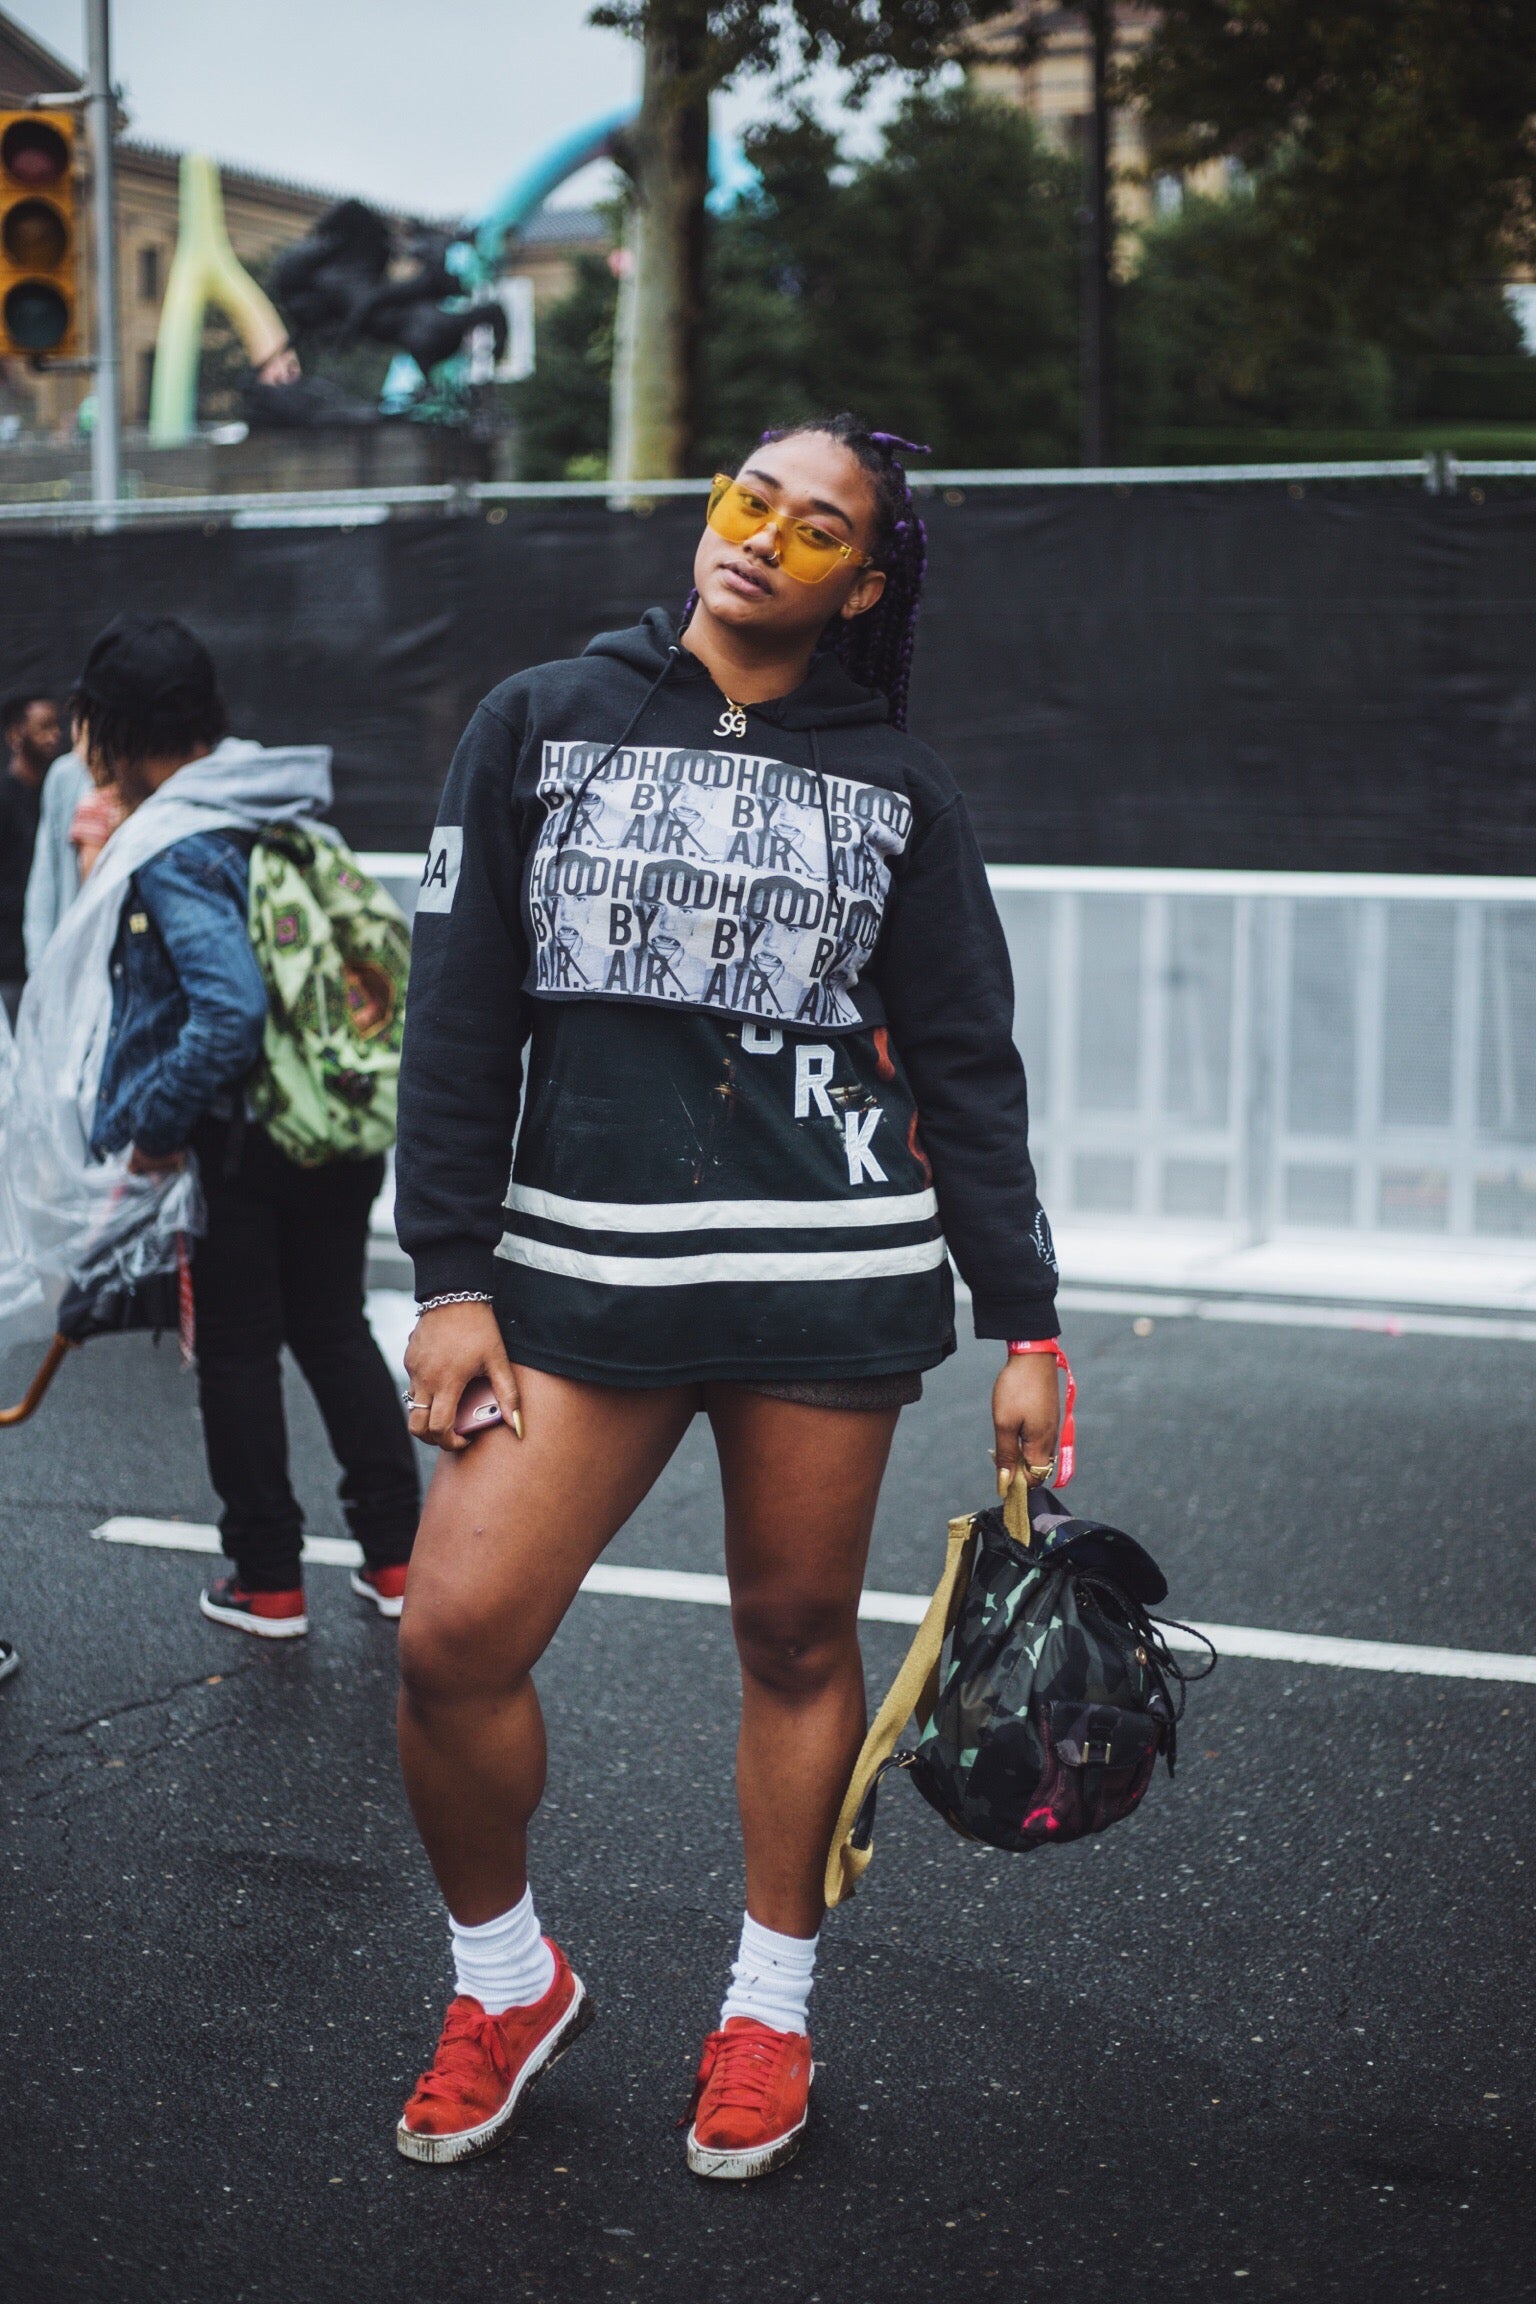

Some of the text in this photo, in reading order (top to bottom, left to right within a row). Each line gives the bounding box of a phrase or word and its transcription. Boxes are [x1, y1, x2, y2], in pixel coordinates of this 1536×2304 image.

[631, 783, 681, 820] BY
[732, 794, 779, 834] BY
[831, 815, 873, 849] BY
[638, 751, 735, 788] HOOD
[736, 758, 828, 808] HOOD
[831, 781, 912, 839] HOOD
[621, 814, 696, 857] AIR.
[727, 831, 802, 874] AIR.
[531, 856, 611, 899] HOOD
[611, 858, 719, 910] HOOD
[718, 873, 824, 929] HOOD
[531, 901, 853, 979] BY BY BY BY
[538, 946, 580, 988] AIR.
[604, 949, 677, 998] AIR.
[704, 963, 773, 1016] AIR.
